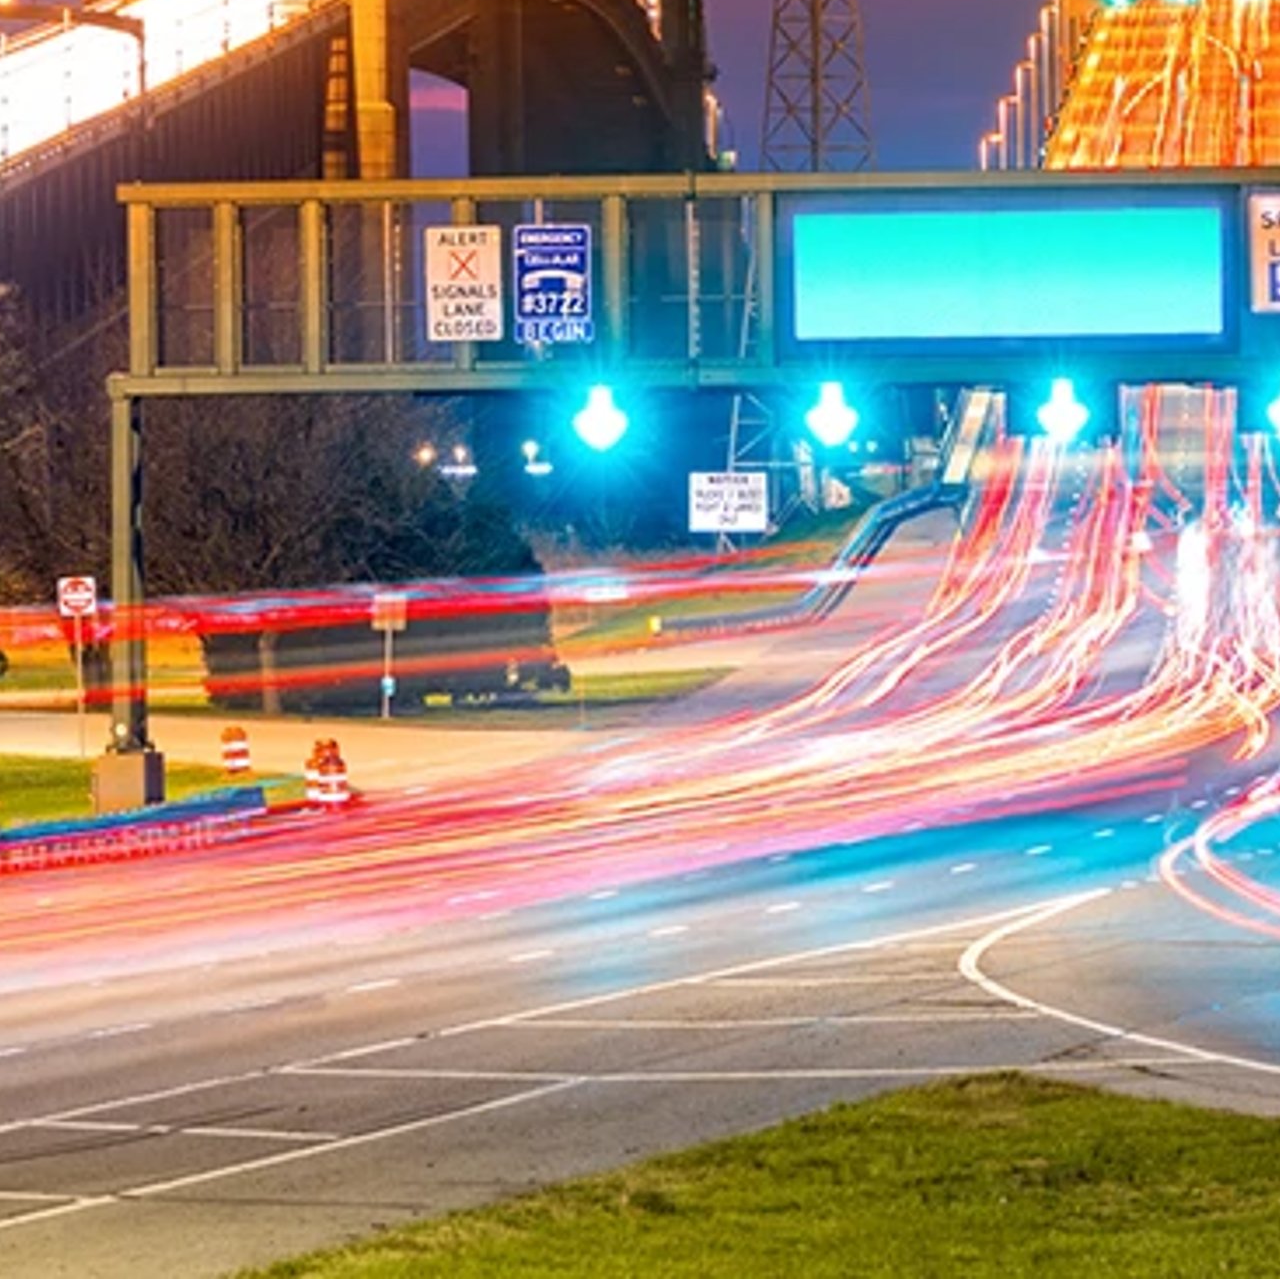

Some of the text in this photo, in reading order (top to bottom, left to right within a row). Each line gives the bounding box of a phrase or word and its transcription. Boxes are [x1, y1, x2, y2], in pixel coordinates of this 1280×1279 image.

[437, 231, 488, 247] ALERT
[521, 232, 583, 244] EMERGENCY
[431, 284, 497, 300] SIGNALS
[443, 302, 485, 318] LANE
[522, 293, 584, 314] #3722
[433, 320, 497, 337] CLOSED
[523, 321, 586, 342] BEGIN
